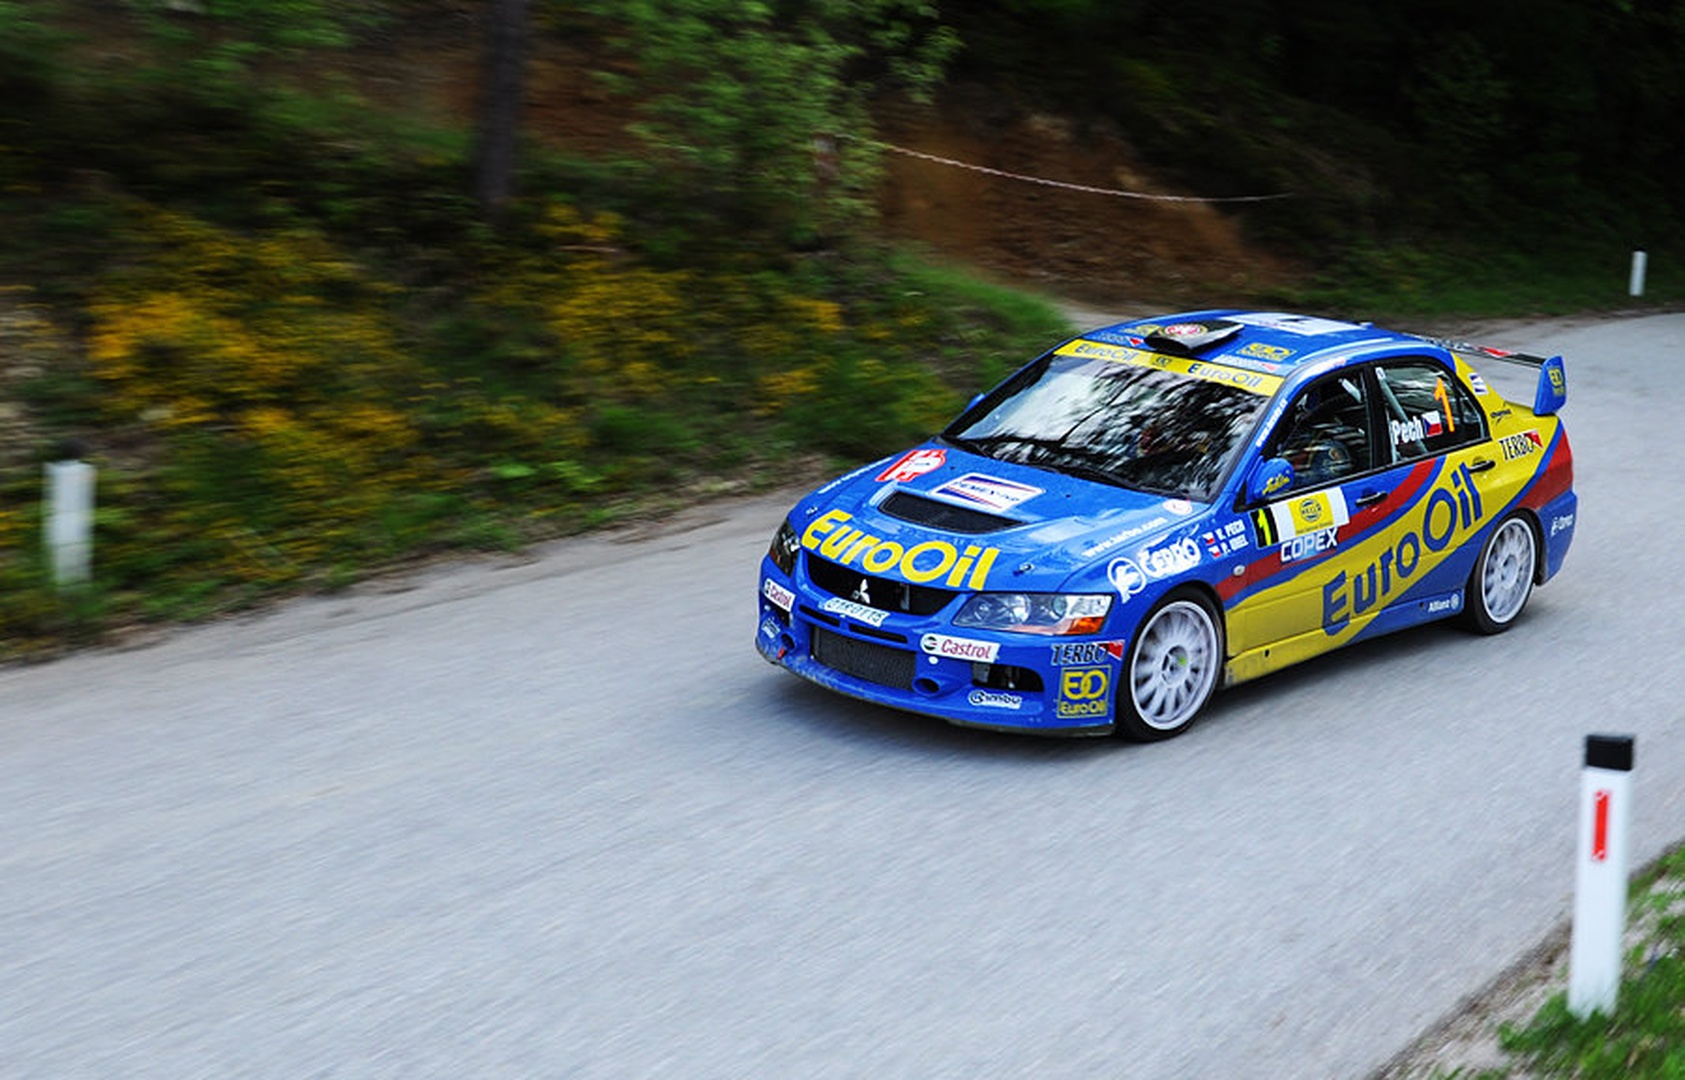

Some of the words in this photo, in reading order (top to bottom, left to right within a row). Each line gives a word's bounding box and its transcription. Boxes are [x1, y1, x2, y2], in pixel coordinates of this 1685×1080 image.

[1075, 343, 1140, 361] EuroOil
[1187, 362, 1263, 388] EuroOil
[1434, 376, 1456, 433] 1
[1391, 415, 1425, 445] Pech
[1257, 508, 1272, 547] 1
[801, 509, 1000, 591] EuroOil
[1281, 528, 1338, 563] COPEX
[1322, 462, 1483, 636] EuroOil
[941, 638, 992, 659] Castrol
[1053, 642, 1109, 664] TERBO
[1063, 670, 1108, 700] EO
[1060, 701, 1107, 716] EuroOil
